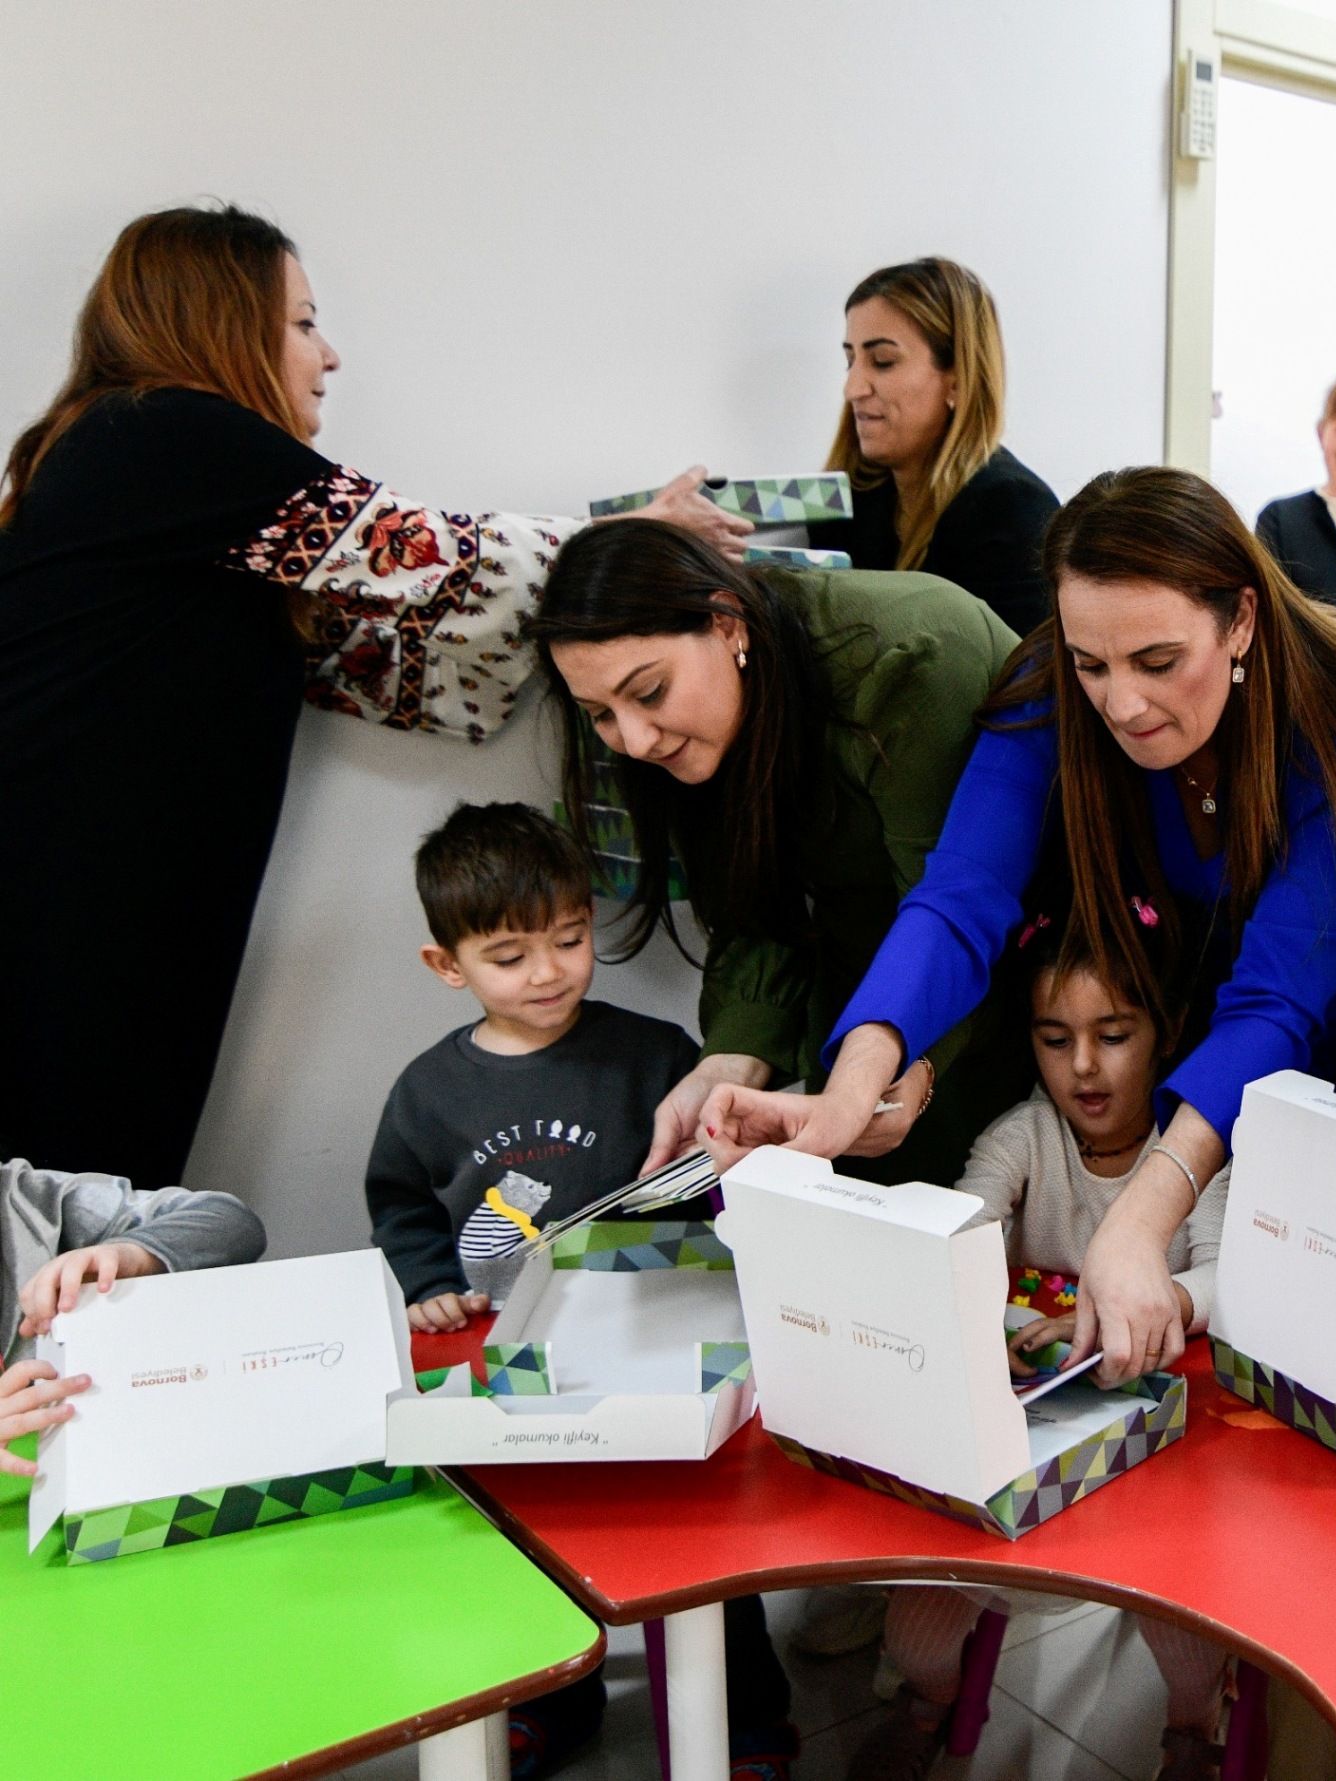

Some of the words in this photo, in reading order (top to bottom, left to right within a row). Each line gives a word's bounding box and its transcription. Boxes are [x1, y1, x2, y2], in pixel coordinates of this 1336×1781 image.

[473, 1125, 521, 1165] BEST
[780, 1313, 818, 1333] Bornova
[131, 1366, 188, 1381] Belediyesi
[131, 1374, 188, 1389] Bornova
[502, 1433, 560, 1446] okumalar
